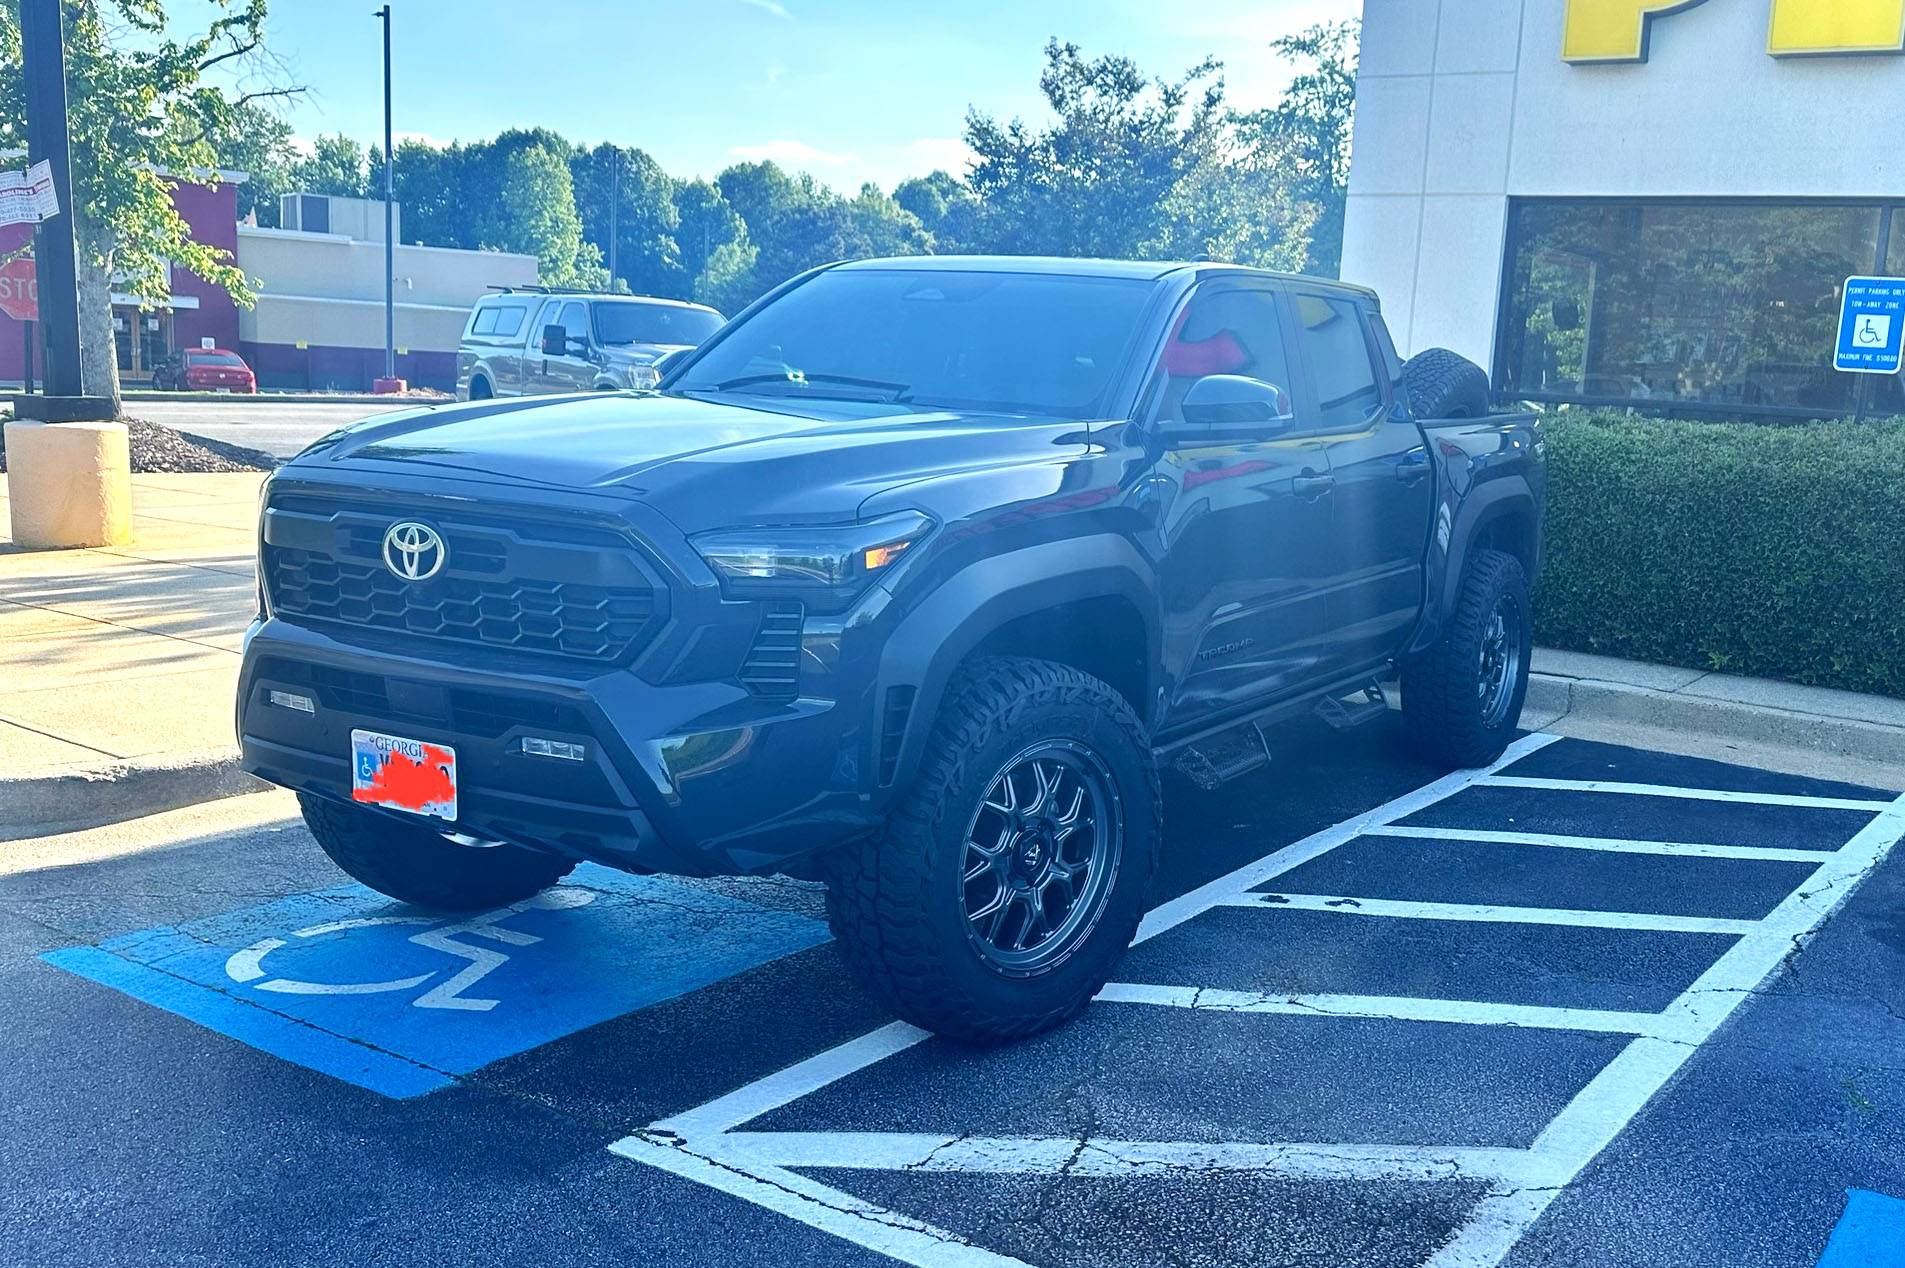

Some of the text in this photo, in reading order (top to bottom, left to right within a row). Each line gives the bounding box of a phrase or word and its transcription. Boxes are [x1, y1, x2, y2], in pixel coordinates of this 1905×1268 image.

[0, 276, 38, 301] STO
[1848, 287, 1865, 295] PERMIT
[1852, 300, 1900, 309] TOW-AWAY ZONE
[1838, 353, 1860, 361] MAXIMUM
[1862, 353, 1873, 361] FINE
[375, 736, 426, 759] GEORGI
